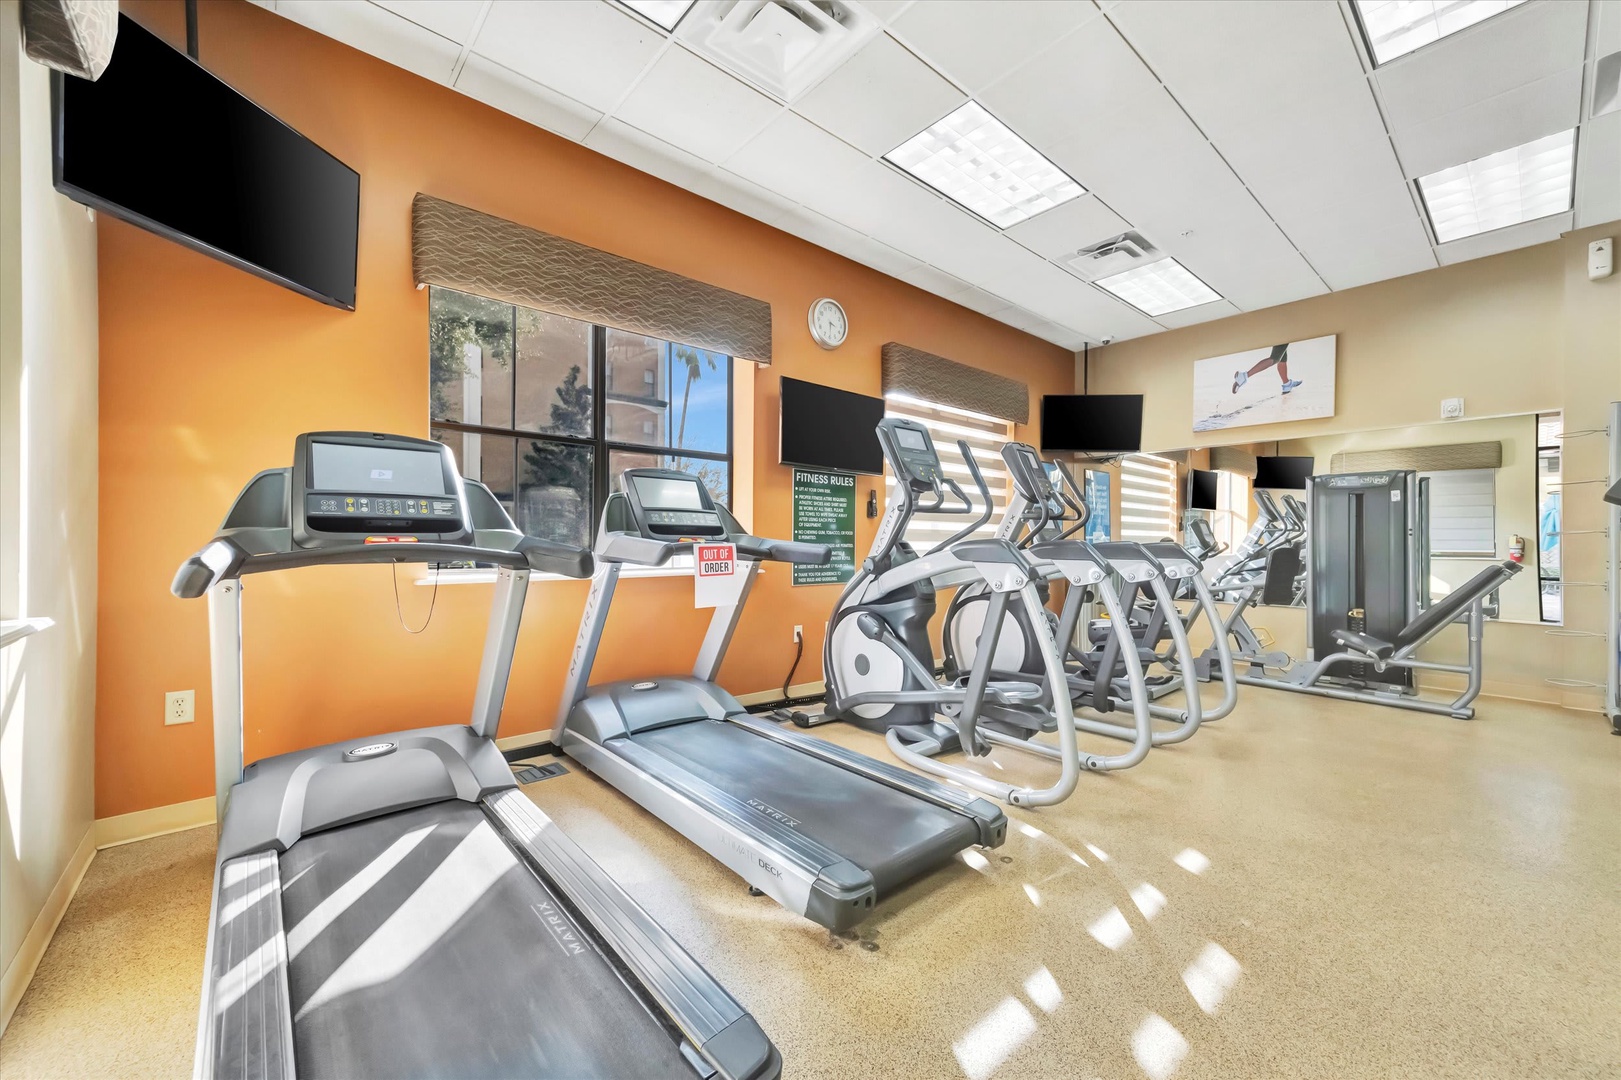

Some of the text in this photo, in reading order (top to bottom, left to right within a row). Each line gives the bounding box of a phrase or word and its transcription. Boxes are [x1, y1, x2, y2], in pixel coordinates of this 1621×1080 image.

[796, 472, 854, 486] FITNESS RULES
[876, 506, 896, 554] MATRIX
[1001, 514, 1016, 538] TRIX
[703, 549, 729, 560] OUT OF
[704, 562, 729, 573] ORDER
[570, 583, 598, 676] MATRIX
[746, 799, 799, 828] MATRIX
[758, 858, 784, 880] DECK
[537, 901, 585, 955] MATRIX
